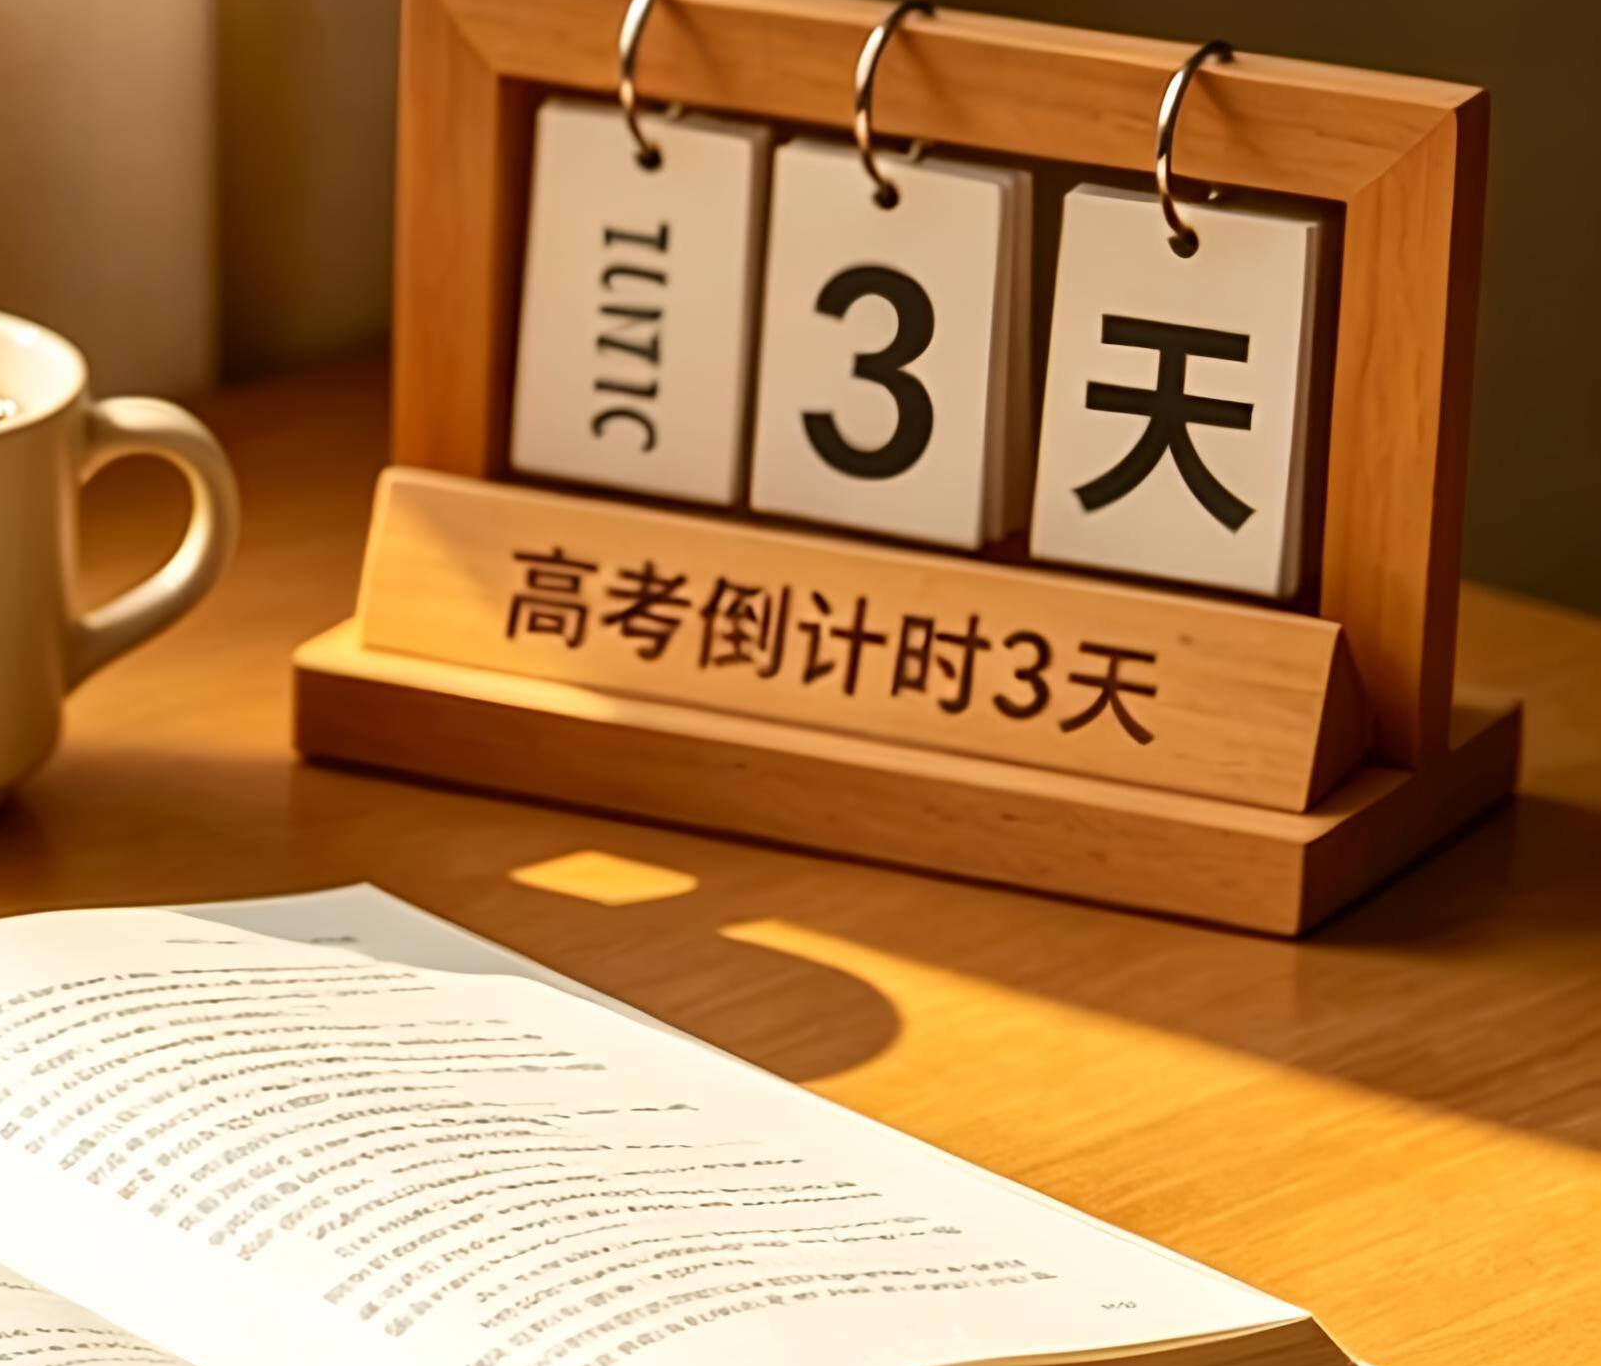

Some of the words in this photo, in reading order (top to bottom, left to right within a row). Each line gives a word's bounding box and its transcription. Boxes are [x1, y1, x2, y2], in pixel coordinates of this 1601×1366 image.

[802, 265, 934, 480] 3
[1073, 314, 1255, 532] 天
[505, 546, 1159, 746] 高考倒计时3天
